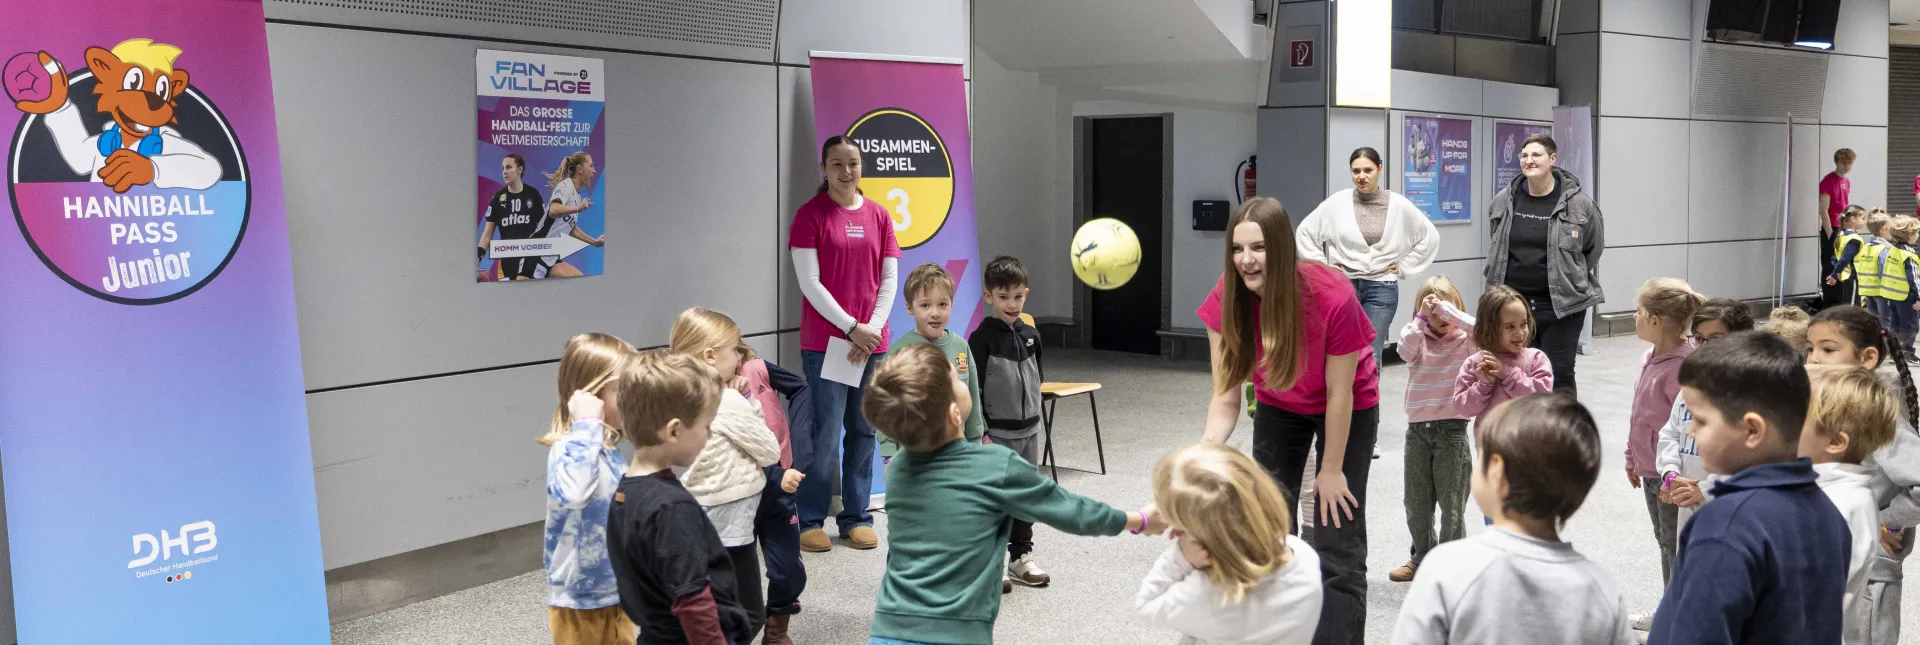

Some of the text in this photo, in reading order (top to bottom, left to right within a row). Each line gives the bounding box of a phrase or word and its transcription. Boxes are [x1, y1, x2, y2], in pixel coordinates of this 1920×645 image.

[496, 61, 545, 77] FAN
[489, 76, 591, 94] VILLAGE
[510, 106, 573, 119] DAS GROSSE
[491, 120, 591, 133] HANDBALL-FEST ZUR
[491, 134, 590, 147] WELTMEISTERSCHAFT!
[1441, 139, 1468, 149] HANDS
[1442, 151, 1452, 160] UP
[1453, 151, 1468, 160] FOR
[876, 157, 917, 171] SPIEL
[1444, 164, 1465, 173] MORE
[63, 194, 215, 219] HANNIBALL
[511, 198, 522, 213] 10
[886, 188, 912, 232] 3
[501, 213, 531, 228] atlas
[110, 221, 178, 245] PASS
[494, 245, 520, 253] KOMM
[102, 248, 191, 293] Junior
[127, 520, 218, 569] DHB
[136, 553, 219, 579] Deutscher Handballbund
